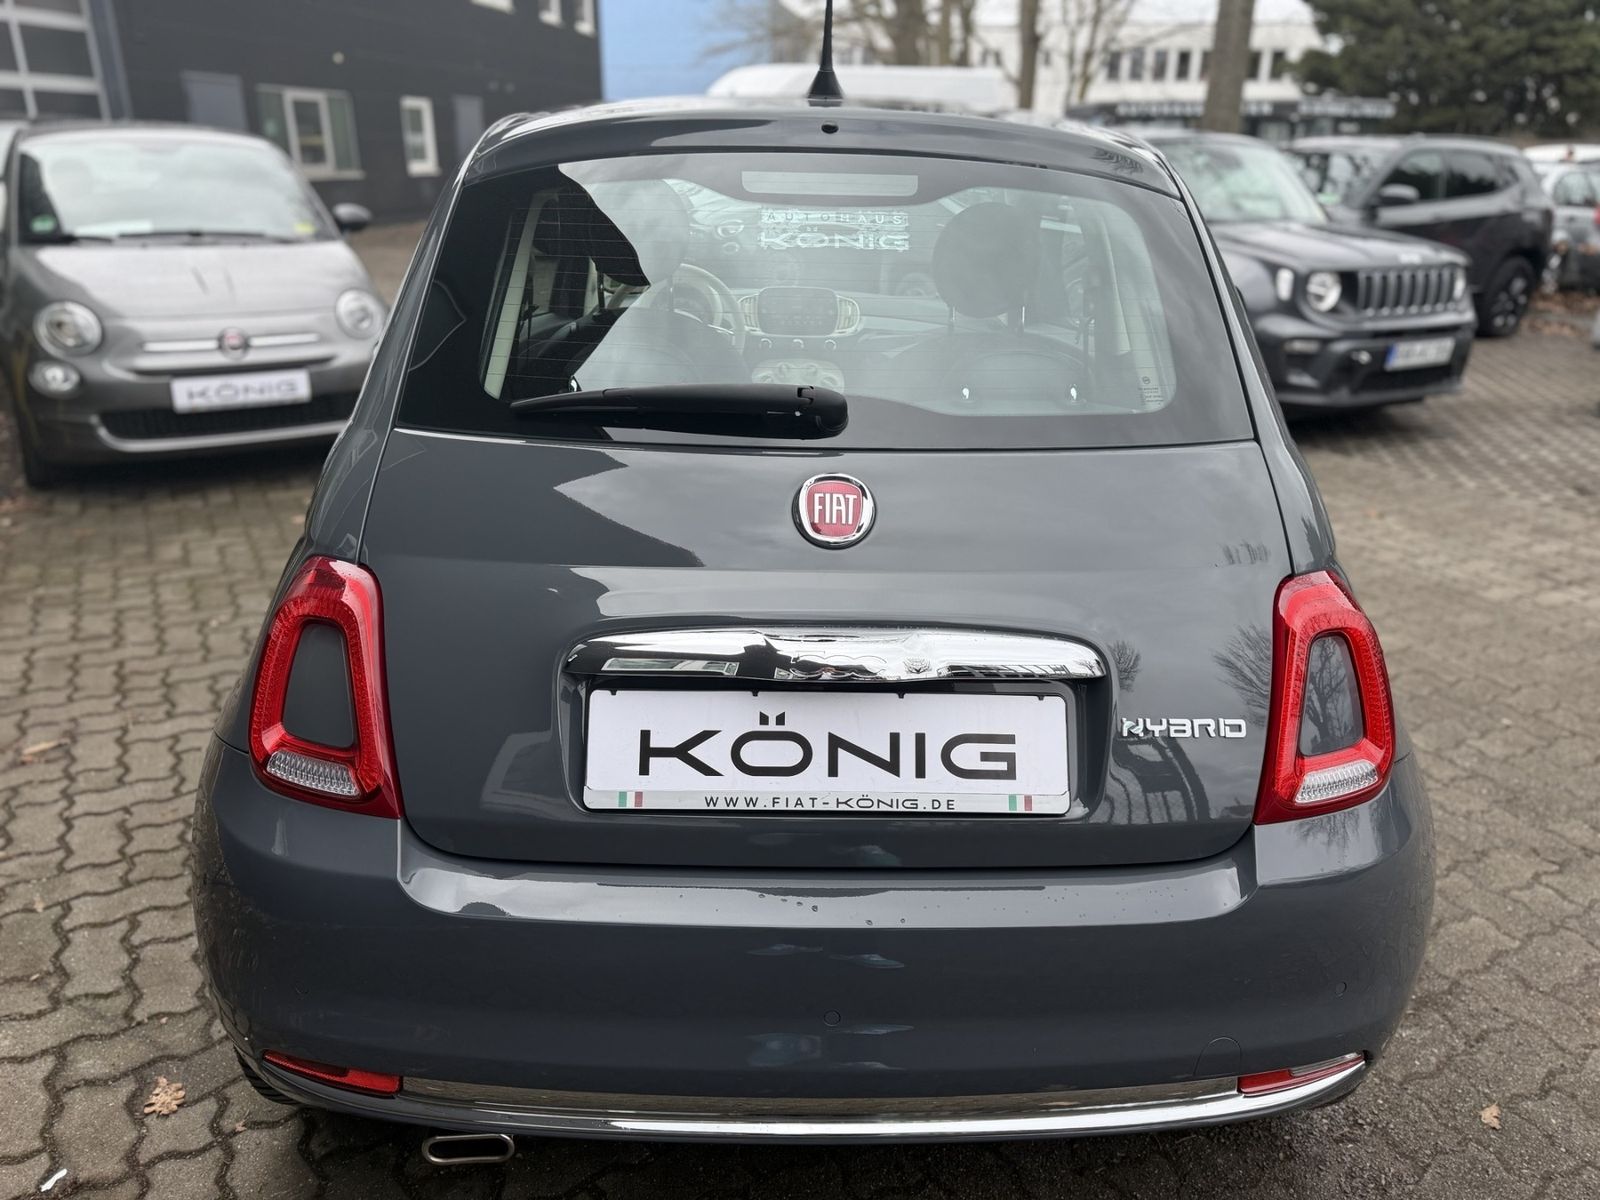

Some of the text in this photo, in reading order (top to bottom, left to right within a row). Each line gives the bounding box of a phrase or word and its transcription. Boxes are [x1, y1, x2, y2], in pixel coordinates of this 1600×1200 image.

[766, 212, 903, 226] AUTOHAUS
[759, 227, 910, 251] KÖNIG
[813, 492, 858, 525] FIAT
[1121, 717, 1248, 738] HYBRID
[638, 711, 1017, 780] KÖNIG
[704, 794, 956, 812] WWW.FIAT-KÖNIG.DE
